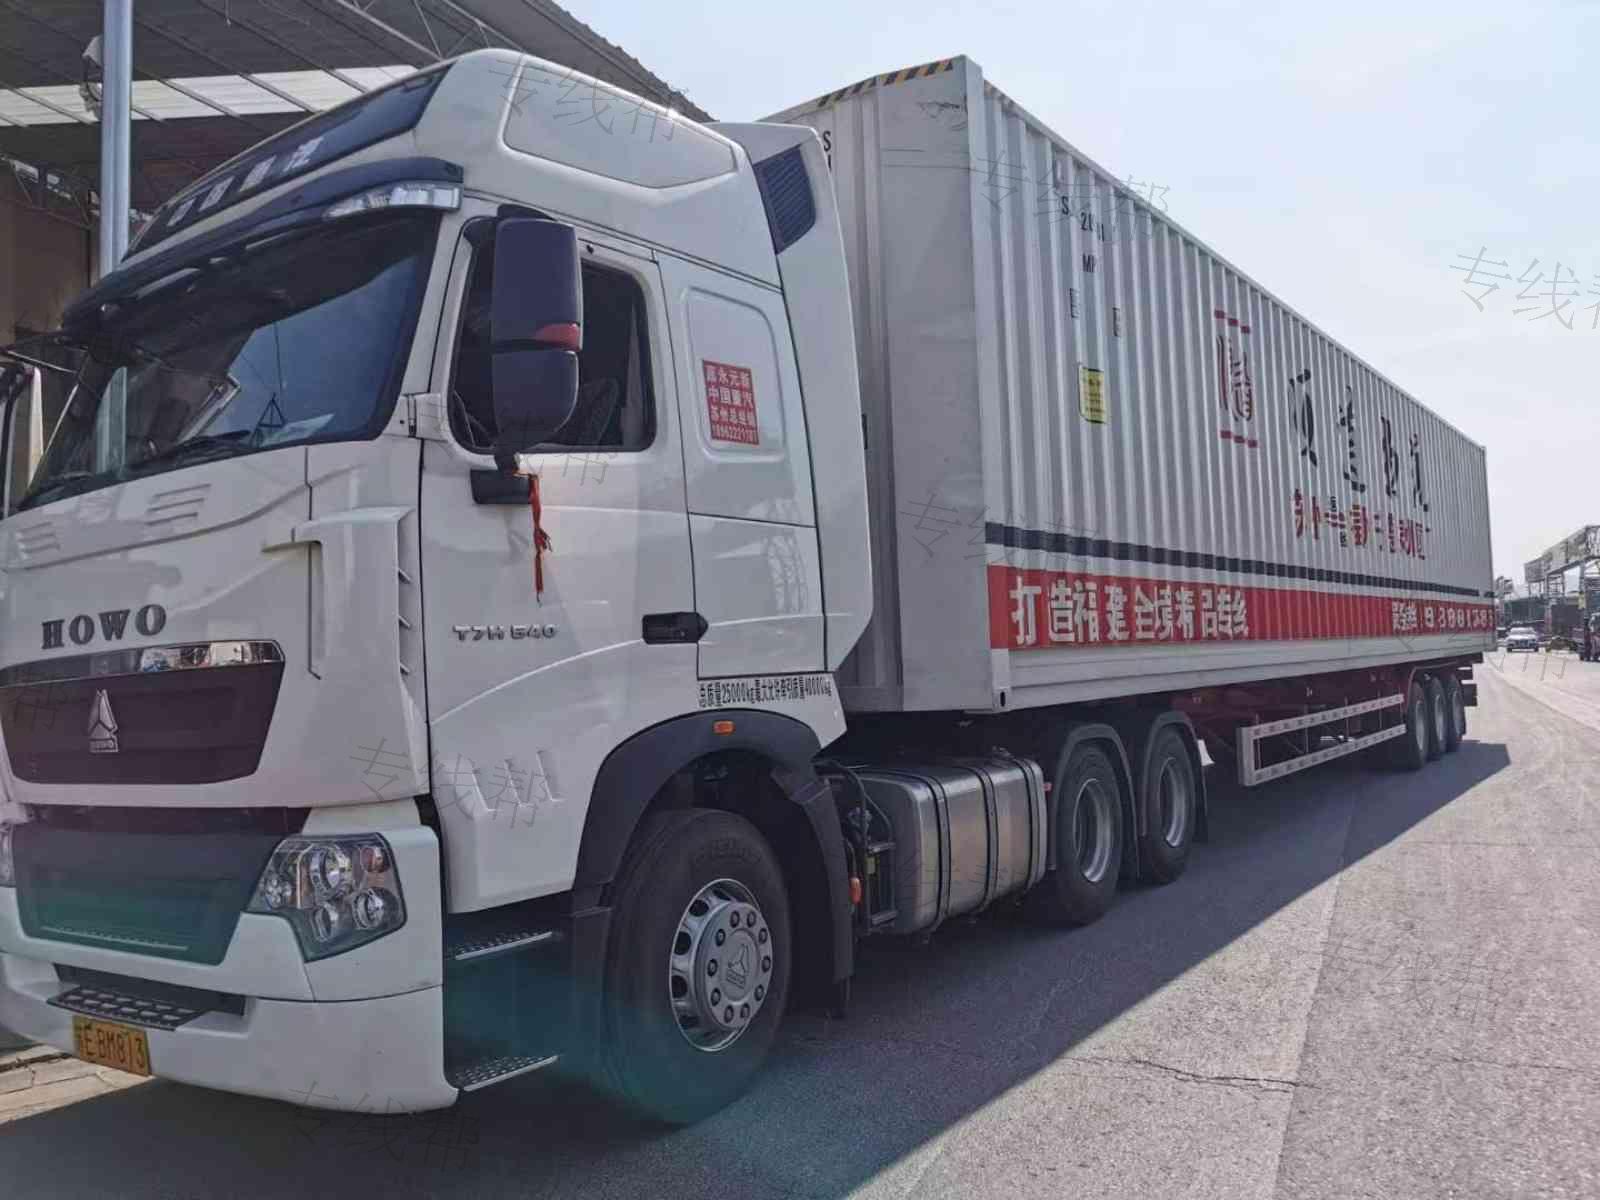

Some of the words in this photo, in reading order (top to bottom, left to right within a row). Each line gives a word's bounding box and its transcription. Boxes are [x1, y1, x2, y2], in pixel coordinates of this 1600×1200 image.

[41, 604, 167, 650] HOWO
[453, 625, 504, 642] T7H
[510, 624, 557, 640] 540
[1009, 575, 1249, 646] 打造福建全境精品专线
